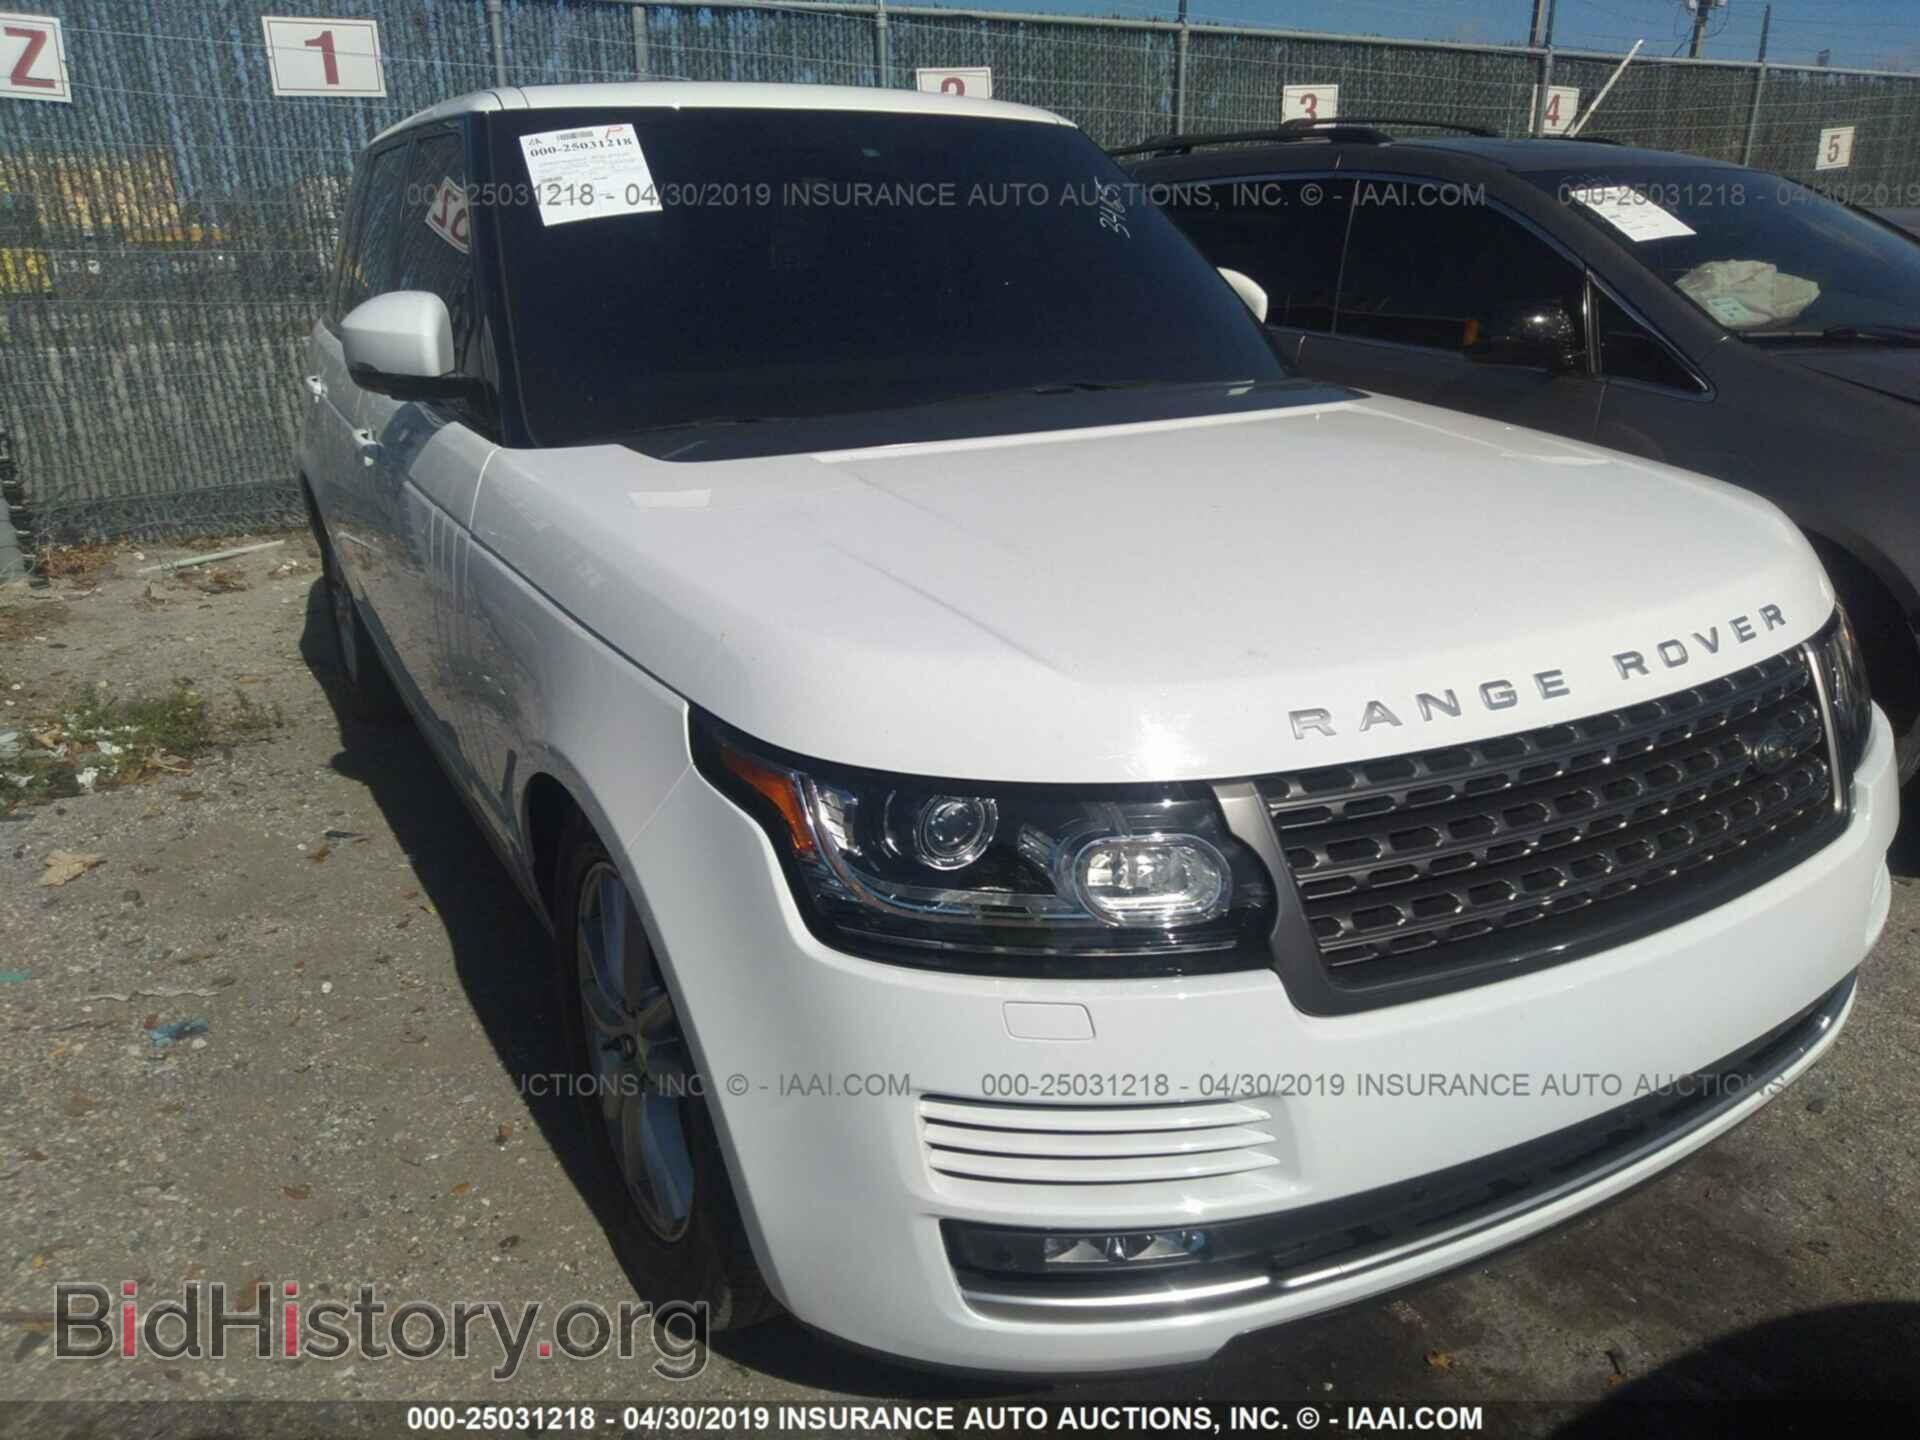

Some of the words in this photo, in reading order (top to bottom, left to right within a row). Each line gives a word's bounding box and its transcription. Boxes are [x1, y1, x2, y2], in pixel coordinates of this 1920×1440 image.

[304, 30, 339, 85] 1
[1300, 93, 1318, 121] 3
[1544, 94, 1560, 127] 4
[1828, 134, 1840, 163] 5
[1288, 669, 1571, 740] RANGE
[1612, 603, 1786, 681] ROVER
